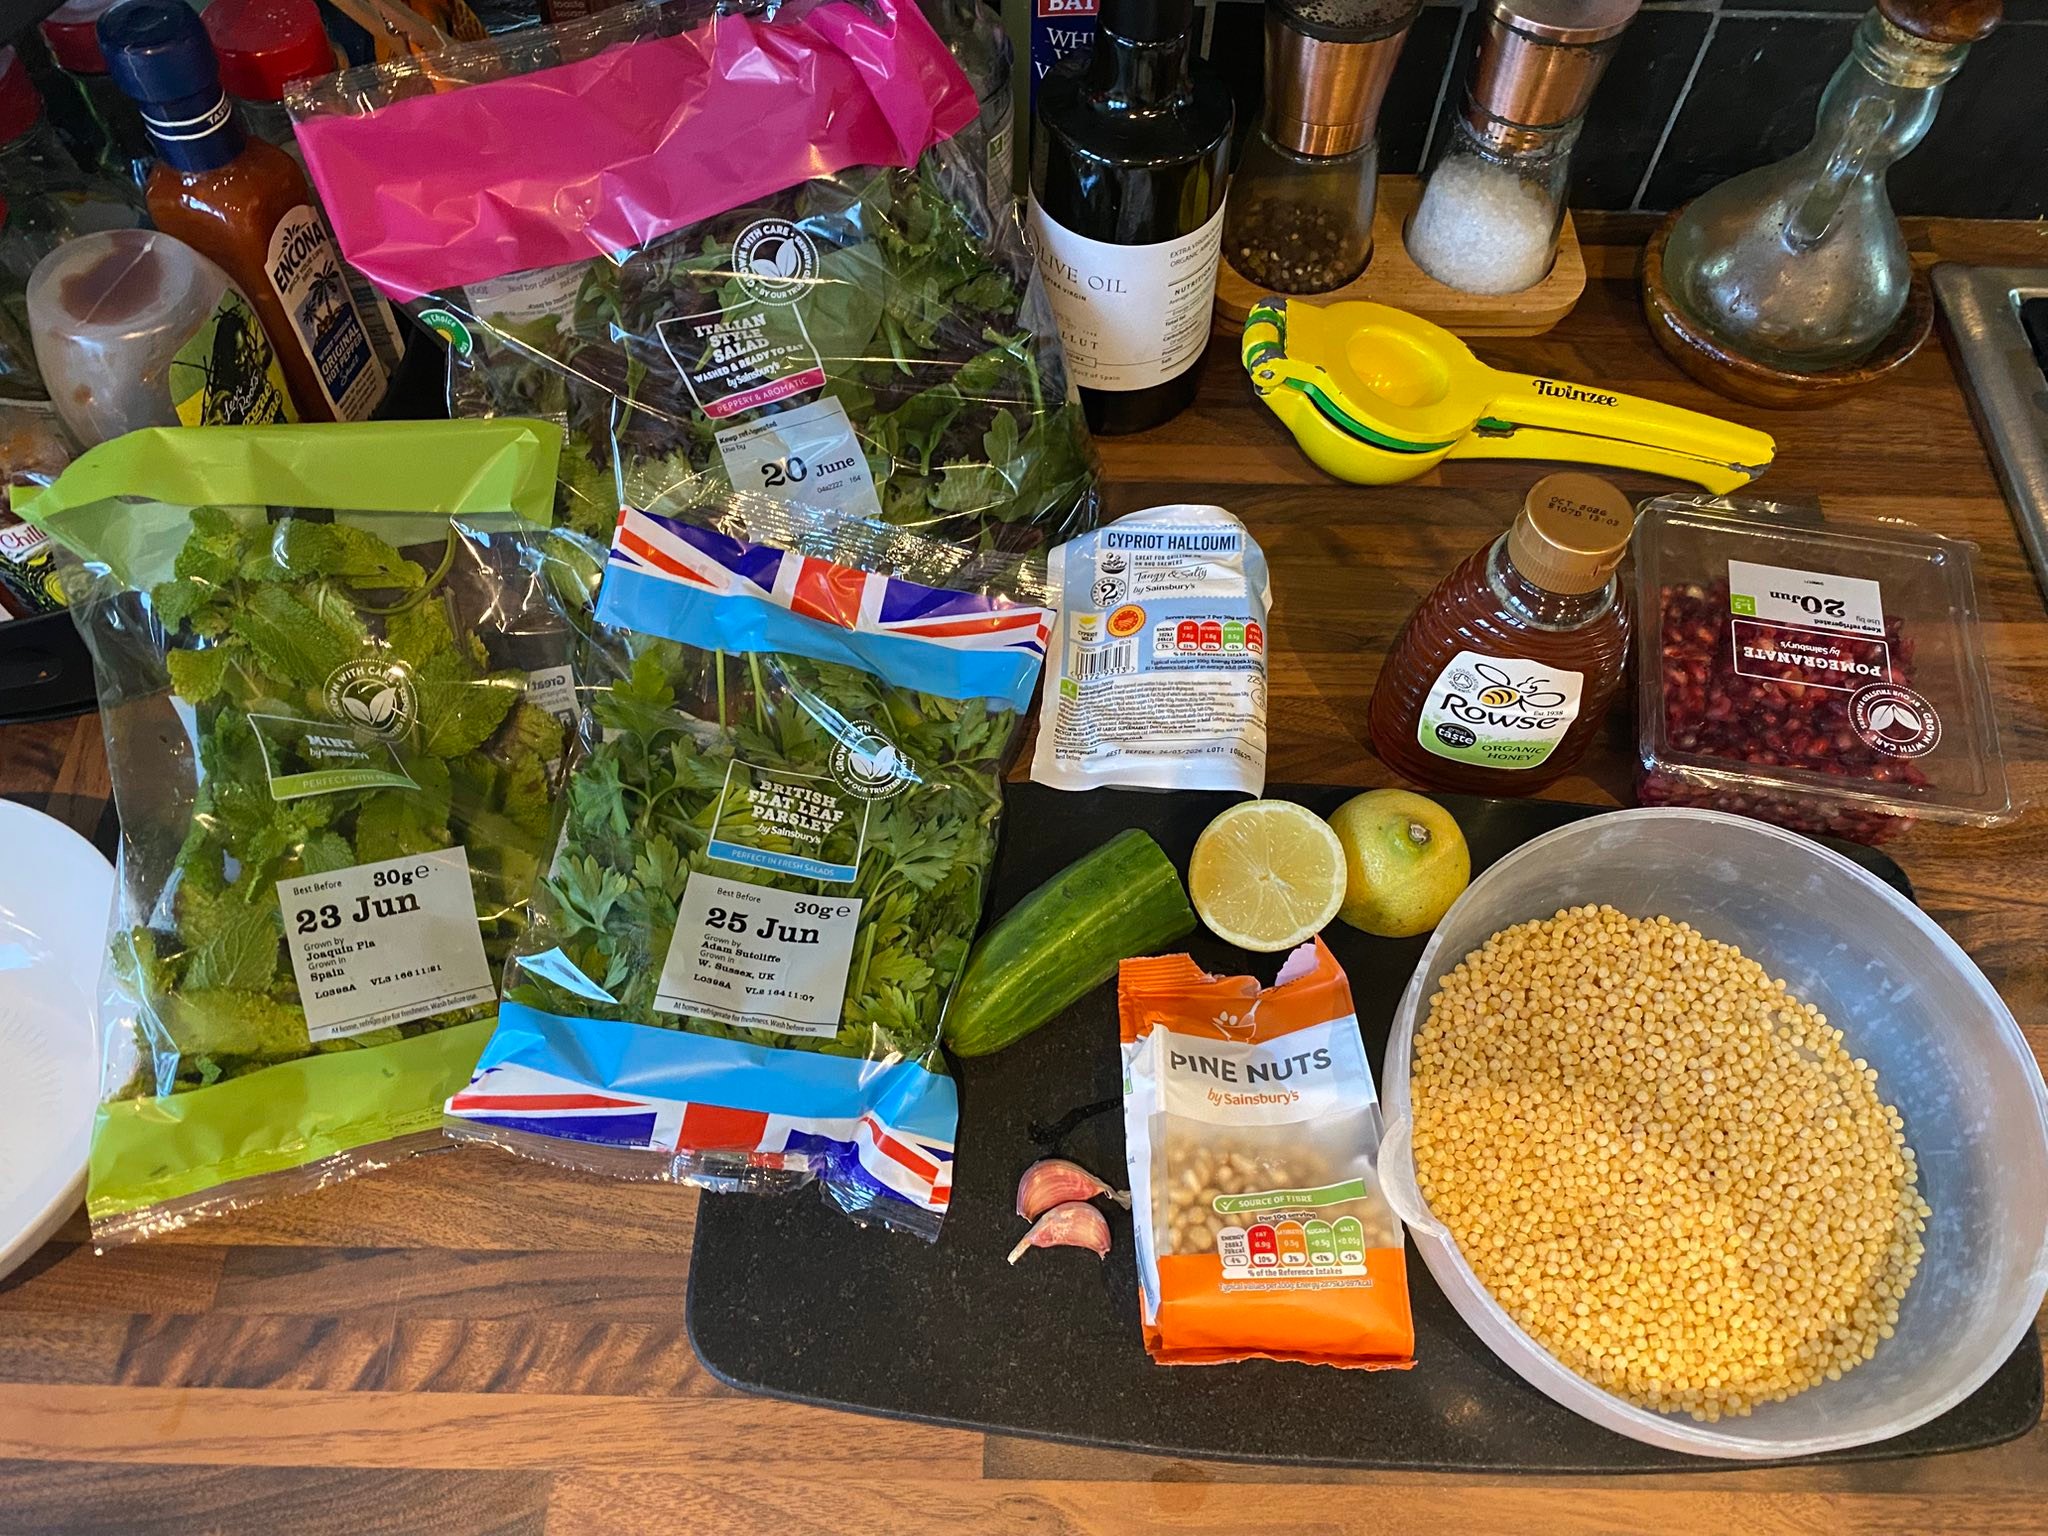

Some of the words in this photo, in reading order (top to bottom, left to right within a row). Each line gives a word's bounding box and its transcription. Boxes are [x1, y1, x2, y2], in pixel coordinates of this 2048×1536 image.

[740, 228, 762, 249] WITH
[762, 225, 790, 236] CARE
[273, 222, 326, 295] ENCONA
[1169, 246, 1191, 259] EXTRA
[1169, 250, 1200, 268] ORGANIC
[759, 288, 770, 297] BY
[1088, 275, 1127, 294] OIL
[1063, 289, 1087, 301] VIRGIN
[694, 313, 767, 338] ITALIAN
[709, 328, 763, 348] STYLE
[321, 323, 359, 375] ORIGINAL
[712, 338, 770, 363] SALAD
[326, 364, 341, 385] HOT
[340, 333, 362, 368] PEPPER
[694, 365, 730, 383] WASHED
[730, 363, 738, 372] &
[739, 352, 771, 369] READY
[772, 346, 785, 357] TO
[726, 378, 737, 389] by
[737, 360, 780, 384] Sainsbury's
[716, 395, 754, 413] PEPPERY
[763, 377, 809, 398] AROMATIC
[1532, 379, 1618, 407] Twinzee
[719, 434, 738, 444] Keep
[761, 456, 808, 488] 20
[816, 457, 856, 477] June
[1551, 496, 1573, 507] OCT
[1107, 532, 1164, 548] CYPRIOT
[1168, 535, 1236, 550] HALLOUMI
[1135, 570, 1167, 582] Tangy
[1168, 570, 1180, 579] &
[1180, 566, 1208, 579] Salty
[1101, 583, 1118, 602] 2
[1133, 585, 1145, 594] by
[1145, 583, 1195, 592] Sainsbury's
[1813, 618, 1861, 630] refrigerated
[1855, 615, 1865, 623] by
[1866, 618, 1880, 626] Use
[1862, 623, 1882, 633] Keep
[1780, 641, 1831, 655] Sainsbury's
[1832, 648, 1840, 657] by
[1743, 646, 1882, 676] POMEGRANATE
[338, 667, 365, 684] WITH
[1861, 689, 1891, 703] TRUSTED
[1896, 691, 1911, 702] OUR
[1911, 698, 1921, 708] BY
[1440, 693, 1560, 730] Rowse
[1438, 728, 1474, 745] taste
[1922, 712, 1935, 746] GROWN
[1481, 744, 1546, 754] ORGANIC
[1872, 733, 1897, 751] CARE
[1900, 742, 1925, 753] WITH
[1106, 749, 1122, 757] BEST
[1487, 752, 1535, 761] HONEY
[302, 776, 348, 788] PERFECT
[350, 774, 375, 782] WITH
[843, 777, 853, 786] BY
[852, 783, 868, 793] OUR
[870, 778, 901, 794] TRUSTED
[759, 780, 837, 809] BRITISH
[747, 790, 795, 810] FLAT
[799, 803, 844, 823] LEAF
[751, 805, 834, 834] PARSLEY
[757, 823, 770, 836] by
[770, 825, 821, 845] Sainsbury's
[731, 849, 767, 863] PERFECT
[767, 856, 776, 865] IN
[777, 858, 802, 870] FRESH
[804, 863, 835, 876] SALADS
[293, 886, 312, 896] Best
[314, 879, 342, 892] Before
[717, 887, 734, 897] Best
[736, 891, 761, 903] Before
[296, 904, 342, 935] 23
[352, 892, 421, 923] Jun
[704, 907, 749, 934] 25
[756, 917, 820, 944] Jun
[303, 940, 332, 952] Grown
[334, 936, 345, 946] by
[701, 940, 733, 955] Adam
[704, 933, 730, 945] Grown
[731, 939, 741, 948] by
[306, 945, 353, 962] Joaquin
[356, 940, 376, 951] Pla
[700, 949, 726, 961] Grown
[308, 959, 336, 971] Grown
[698, 958, 711, 968] W.
[714, 962, 754, 979] Sussex,
[758, 971, 775, 981] UK
[310, 967, 345, 982] Spain
[339, 1023, 358, 1033] home,
[359, 1014, 391, 1029] refrigerate
[430, 1000, 447, 1010] Wash
[447, 995, 465, 1007] before
[682, 1003, 699, 1014] home,
[700, 1007, 730, 1021] refrigerate
[731, 1013, 740, 1022] for
[770, 1018, 786, 1028] Wash
[786, 1022, 804, 1031] before
[1170, 1050, 1237, 1083] PINE
[1247, 1048, 1332, 1084] NUTS
[1207, 1087, 1223, 1105] by
[1224, 1089, 1299, 1105] Sainsbury's
[1238, 1197, 1272, 1208] SOURCE
[1286, 1195, 1313, 1203] FIBRE
[1256, 1268, 1264, 1276] of
[1265, 1268, 1277, 1276] the
[1278, 1268, 1314, 1276] Reference
